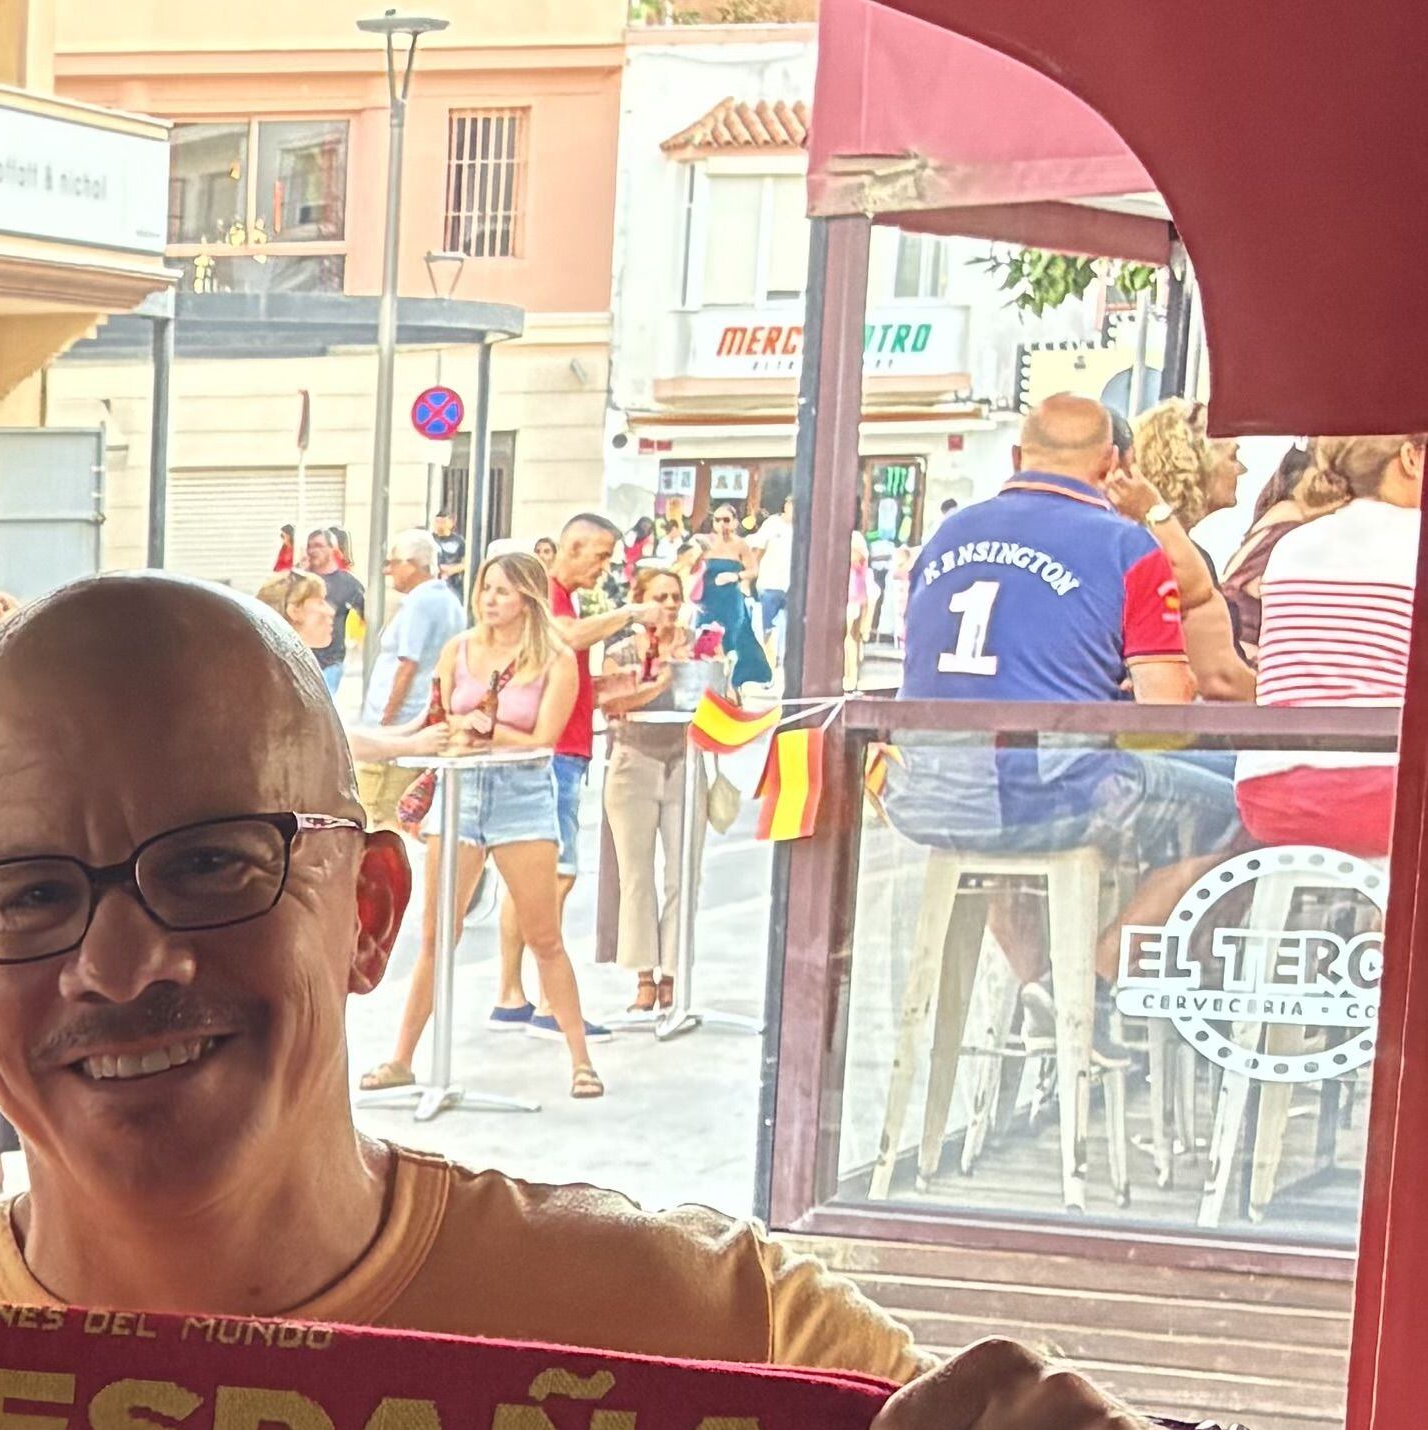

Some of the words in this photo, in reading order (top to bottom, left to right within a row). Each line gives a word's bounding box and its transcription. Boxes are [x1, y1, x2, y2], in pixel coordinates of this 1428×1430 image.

[937, 580, 1001, 676] 1
[1122, 928, 1195, 984] EL
[82, 1310, 157, 1339] DEL
[181, 1315, 338, 1350] MUNDO
